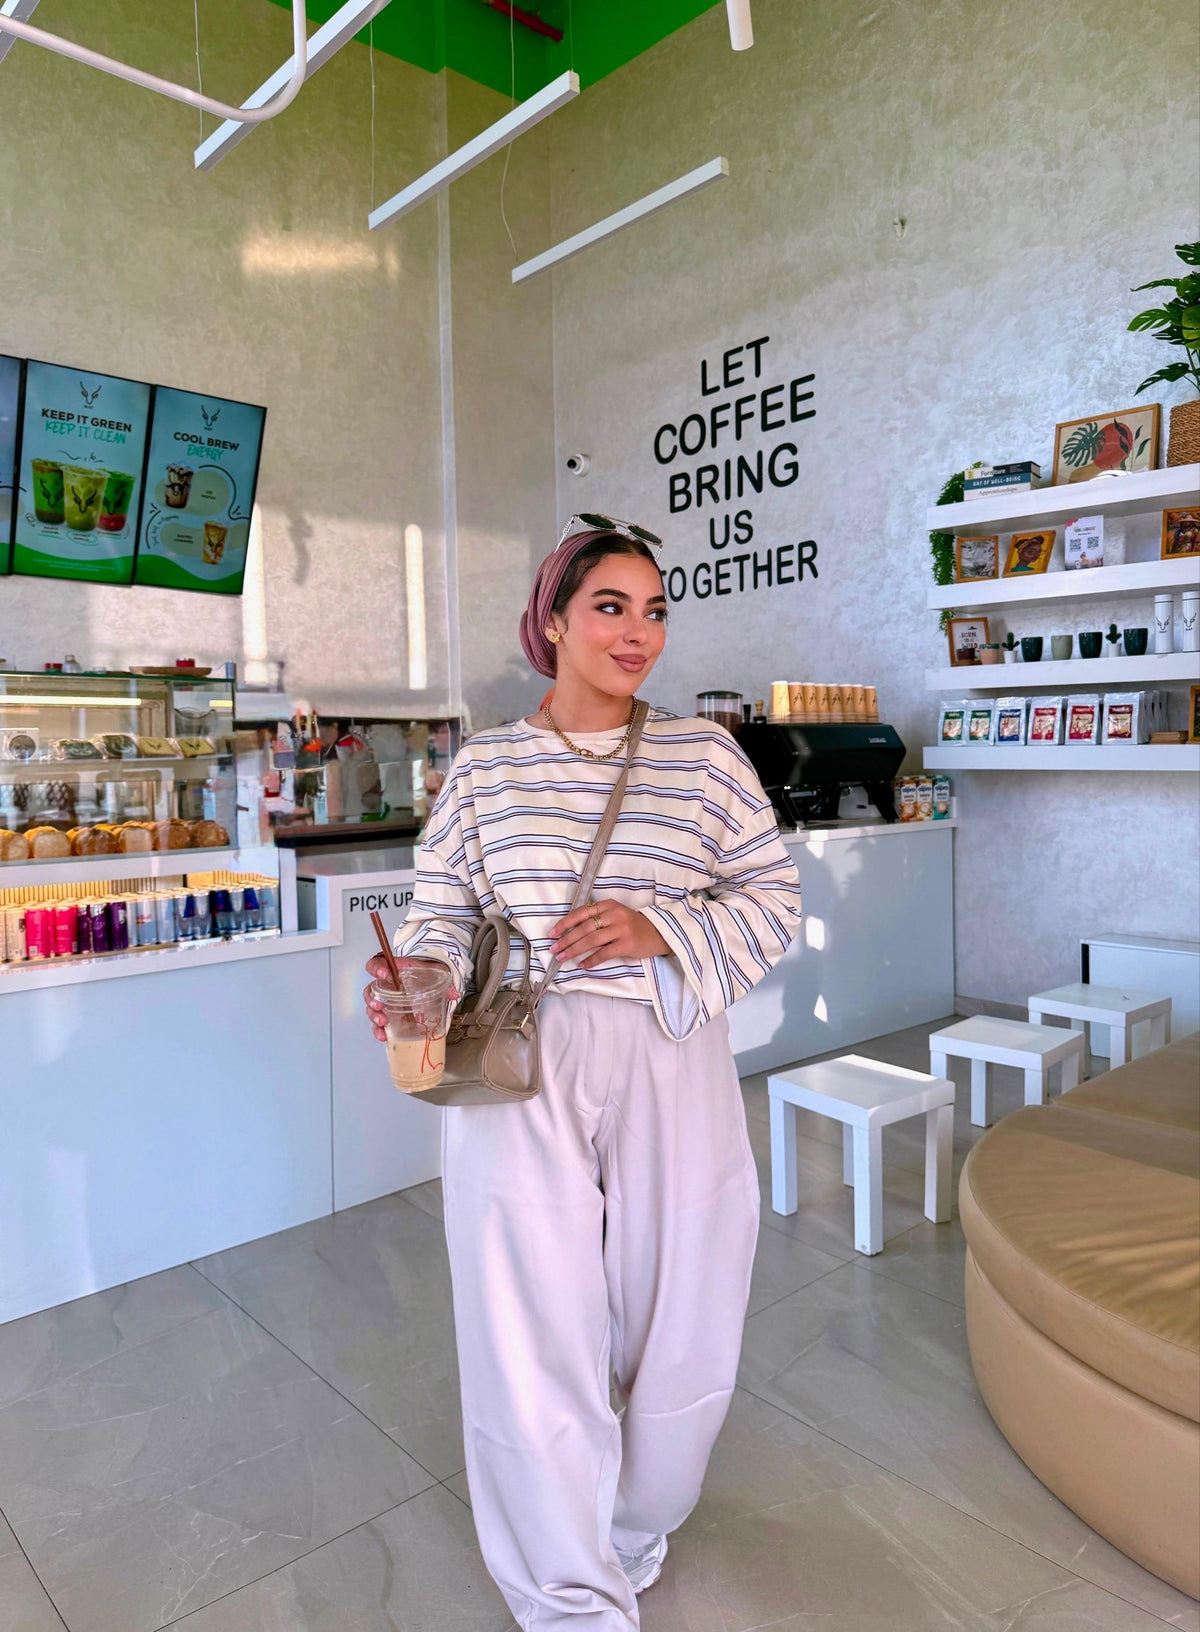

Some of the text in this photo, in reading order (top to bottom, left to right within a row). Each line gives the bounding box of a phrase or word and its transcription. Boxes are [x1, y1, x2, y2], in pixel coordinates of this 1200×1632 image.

[701, 336, 770, 397] LET
[41, 408, 132, 432] KEEP IT GREEN
[45, 420, 127, 445] KEEP IT CLEAN
[653, 373, 817, 465] COFFEE
[173, 431, 240, 451] COOL BREW
[669, 442, 799, 514] BRING
[709, 509, 754, 550] US
[661, 540, 819, 602] OGETHER
[350, 891, 414, 912] PICK UP
